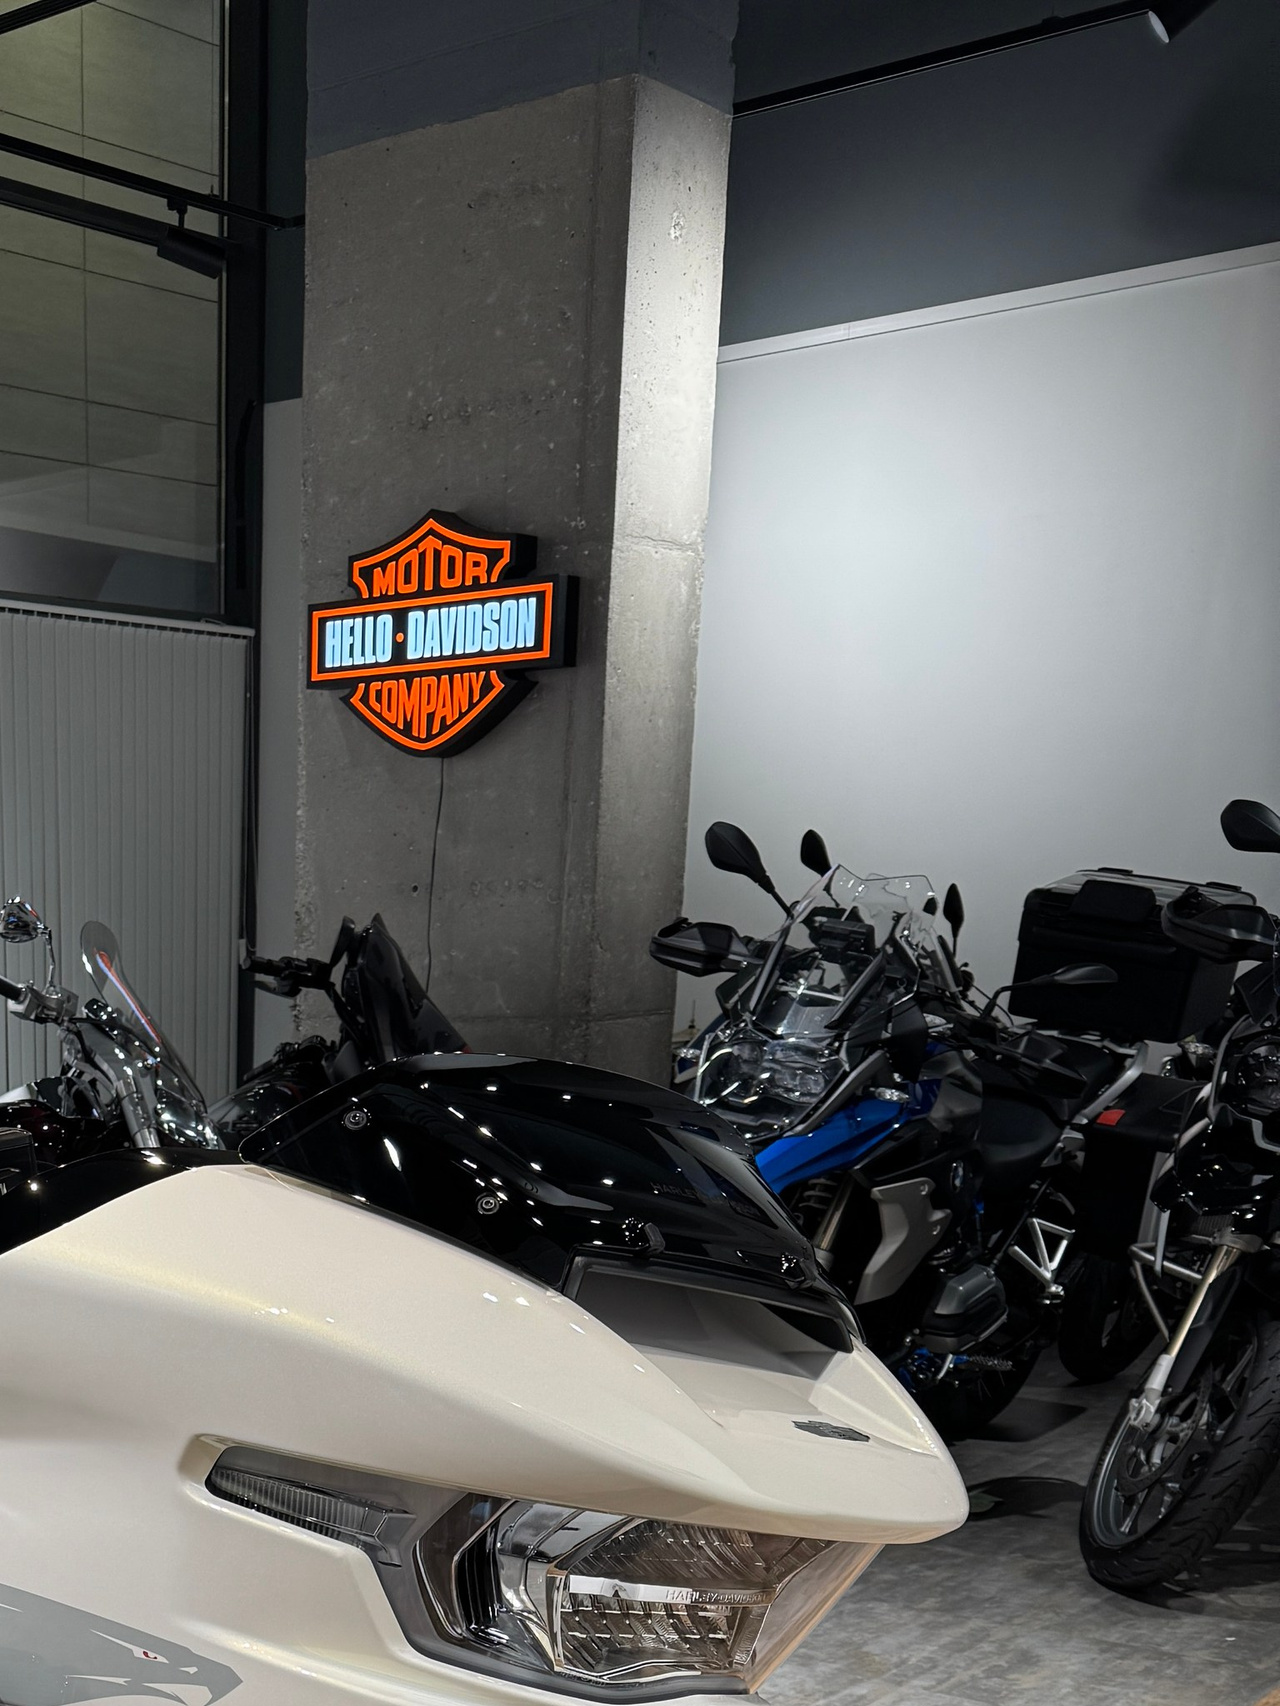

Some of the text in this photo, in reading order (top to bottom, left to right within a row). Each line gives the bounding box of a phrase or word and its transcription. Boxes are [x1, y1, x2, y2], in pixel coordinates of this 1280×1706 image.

[373, 535, 487, 597] MOTOR
[325, 597, 537, 668] HELLO DAVIDSON
[369, 671, 486, 738] COMPANY
